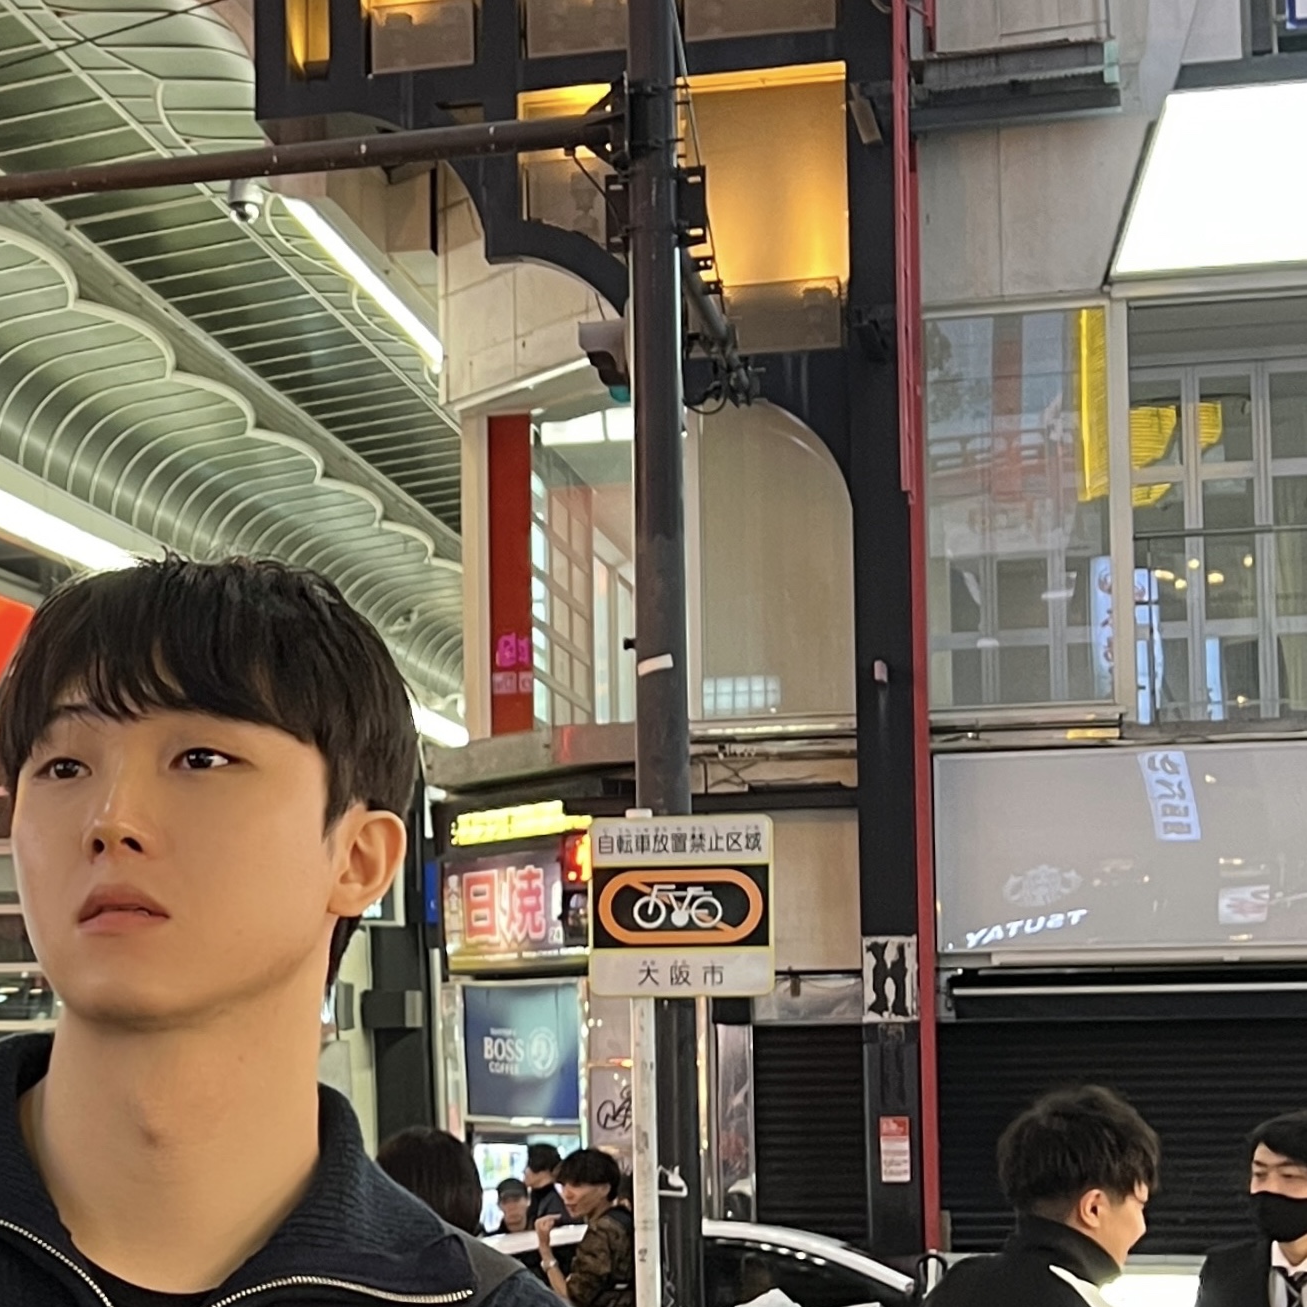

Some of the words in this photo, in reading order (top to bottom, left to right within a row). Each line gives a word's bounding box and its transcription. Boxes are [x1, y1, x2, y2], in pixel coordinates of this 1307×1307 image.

[598, 831, 762, 854] 自転車放置禁止区域
[461, 863, 547, 946] 日焼
[638, 964, 724, 986] 大阪市
[483, 1037, 524, 1062] BOSS
[488, 1060, 520, 1075] COFFEE
